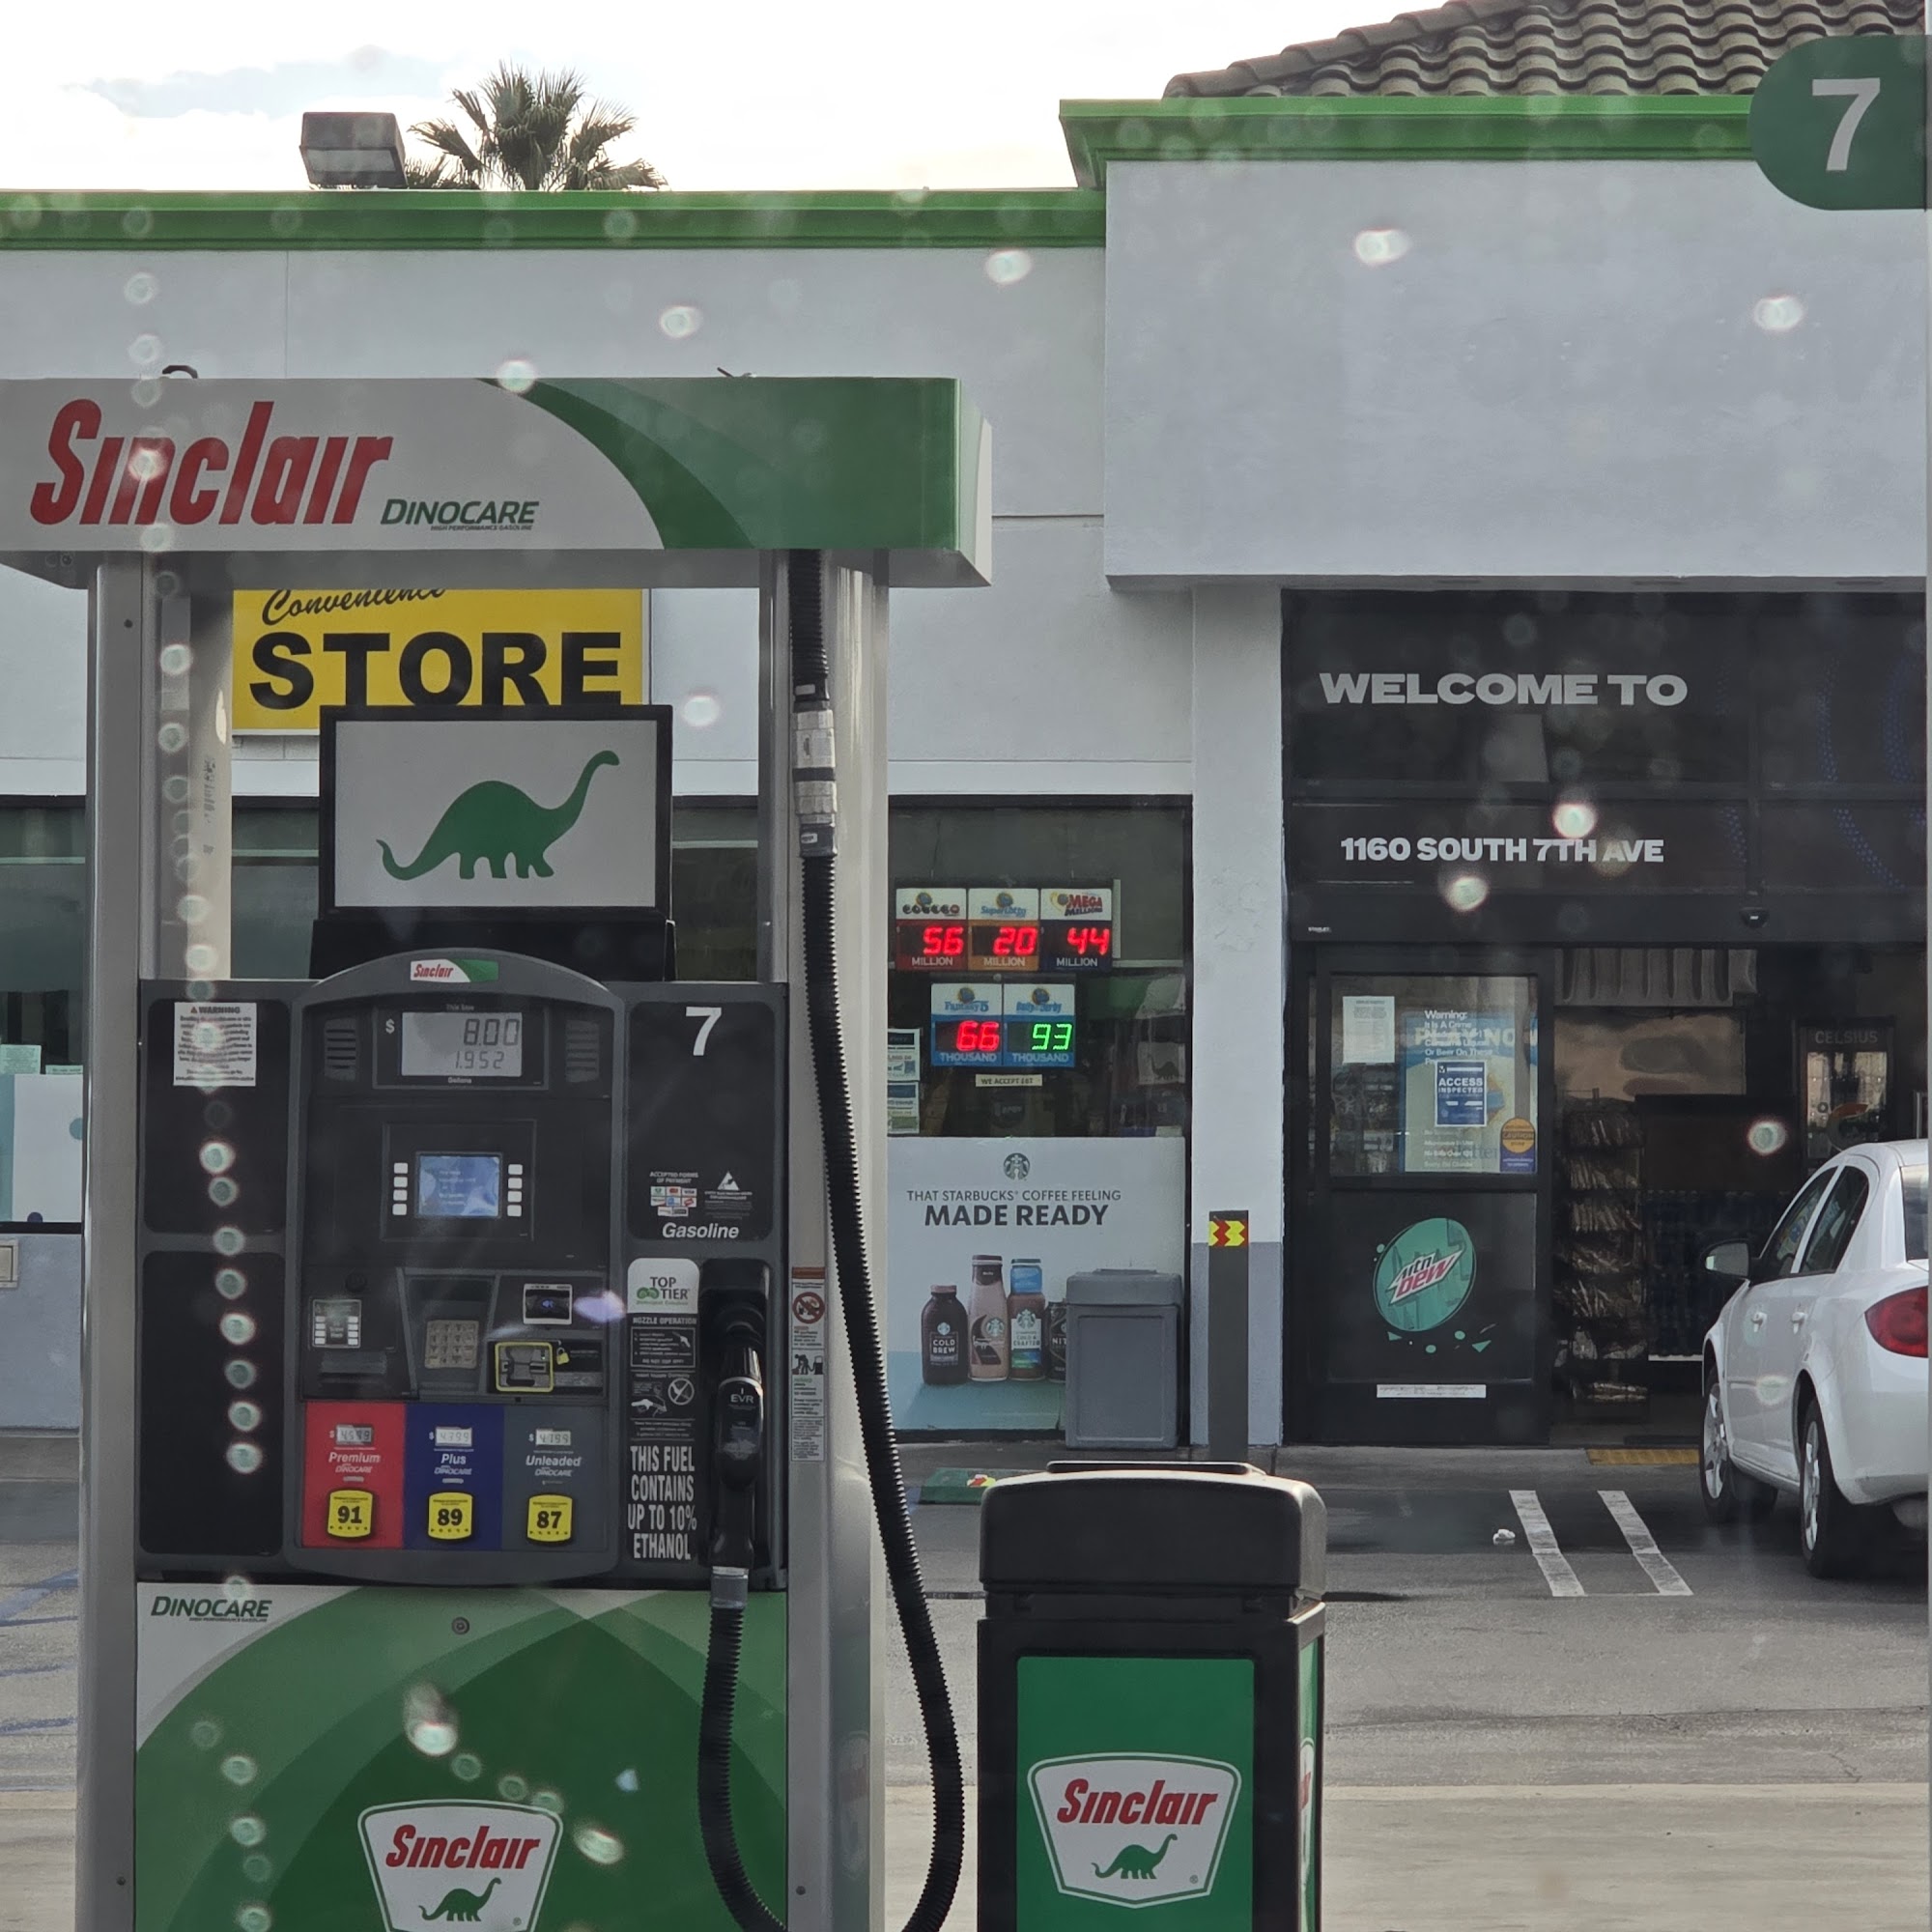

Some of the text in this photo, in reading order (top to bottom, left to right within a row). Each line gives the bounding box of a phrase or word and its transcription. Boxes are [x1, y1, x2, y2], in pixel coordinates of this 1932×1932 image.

[1812, 77, 1881, 171] 7
[30, 398, 394, 526] Sinclair
[381, 498, 539, 525] DINOCARE
[249, 631, 621, 710] STORE
[1320, 672, 1688, 706] WELCOME TO
[1341, 838, 1664, 863] 1160 SOUTH 7TH AVE
[1066, 895, 1103, 908] MEGA
[923, 925, 964, 956] 56
[993, 925, 1038, 956] 20
[1066, 926, 1110, 955] 44
[912, 956, 953, 966] MILLION
[984, 956, 1026, 966] MILLION
[1056, 957, 1098, 967] MILLION
[413, 964, 453, 978] Sinclair
[1424, 1009, 1468, 1021] Warning:
[385, 1018, 520, 1046] $ 8.00
[685, 1006, 723, 1057] 7
[955, 1020, 1000, 1052] 66
[1032, 1023, 1073, 1051] 93
[1815, 1030, 1878, 1044] CELSIUS
[455, 1050, 504, 1069] 1.952
[940, 1053, 998, 1063] THOUSAND
[1012, 1053, 1069, 1063] THOUSAND
[1438, 1077, 1484, 1087] ACCESS
[907, 1190, 939, 1201] THAT
[1022, 1190, 1067, 1202] COFFEE
[1071, 1190, 1122, 1201] FEELING
[924, 1205, 1109, 1226] MADE READY
[662, 1222, 740, 1238] Gasoline
[650, 1276, 676, 1288] TOP
[660, 1289, 689, 1300] TIER
[659, 1317, 697, 1325] OPERATION
[730, 1393, 753, 1404] EVR
[328, 1452, 382, 1463] Premium
[440, 1453, 467, 1464] Plus
[526, 1455, 582, 1466] Unleaded
[630, 1445, 695, 1471] THIS FUEL
[534, 1468, 573, 1477] DINOCARE
[631, 1474, 695, 1501] CONTAINS
[337, 1505, 362, 1523] 91
[437, 1508, 463, 1526] 89
[536, 1510, 562, 1529] 87
[628, 1504, 697, 1530] UP TO 10%
[634, 1533, 692, 1560] ETHANOL
[151, 1596, 273, 1617] DINOCARE
[1057, 1777, 1217, 1826] Sinclair
[385, 1824, 541, 1870] Sinclair
